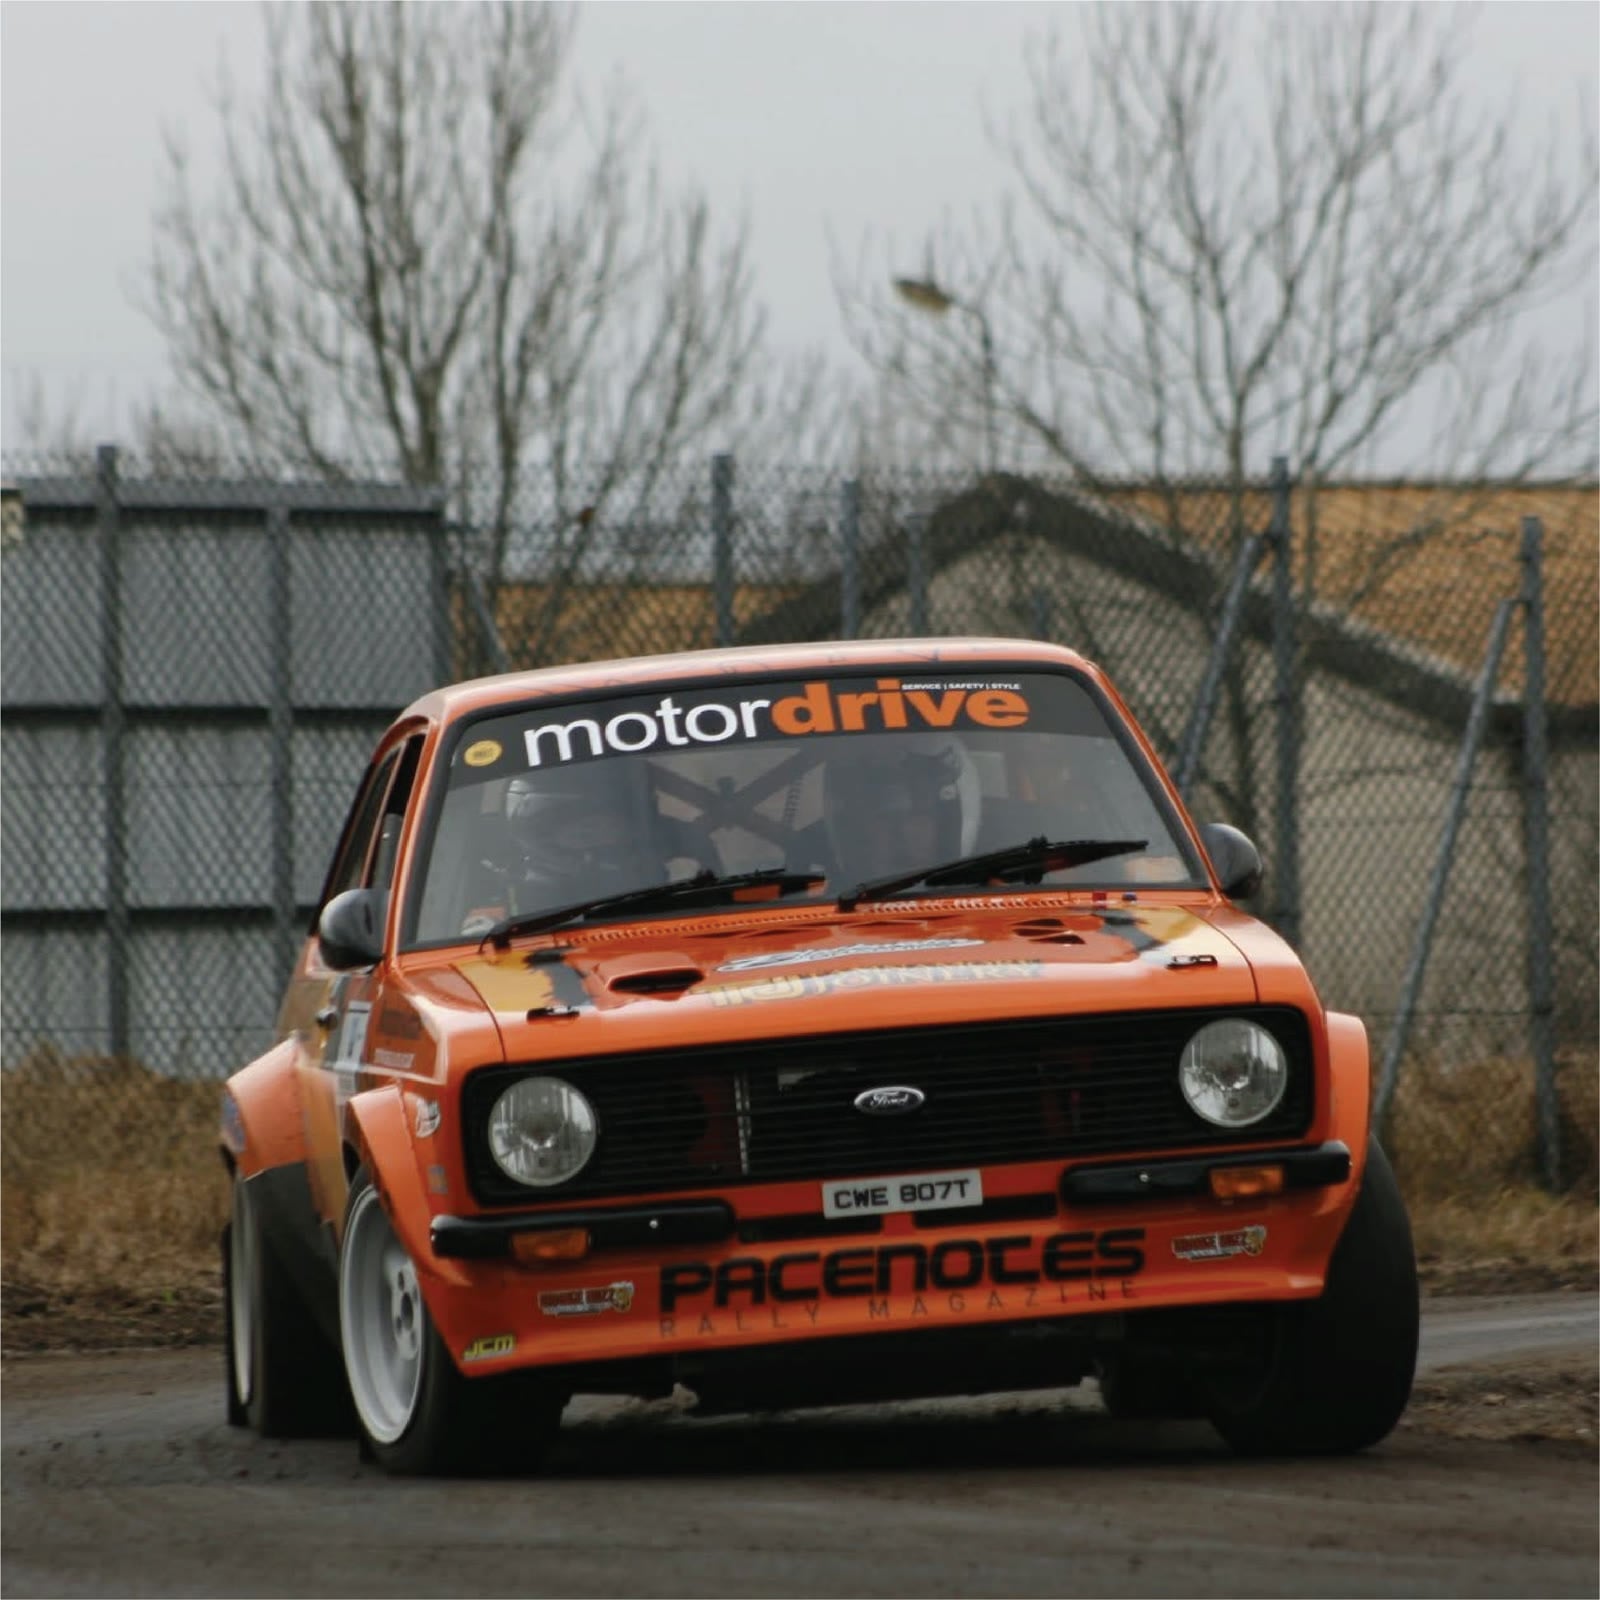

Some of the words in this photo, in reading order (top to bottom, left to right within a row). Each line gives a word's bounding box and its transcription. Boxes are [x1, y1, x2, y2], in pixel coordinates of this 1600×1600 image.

[524, 678, 1029, 767] motordrive
[834, 1186, 889, 1209] CWE
[900, 1179, 970, 1203] 807T
[660, 1228, 1146, 1313] PACENOTES
[659, 1303, 820, 1338] RALLY
[868, 1280, 1136, 1320] MAGAZINE
